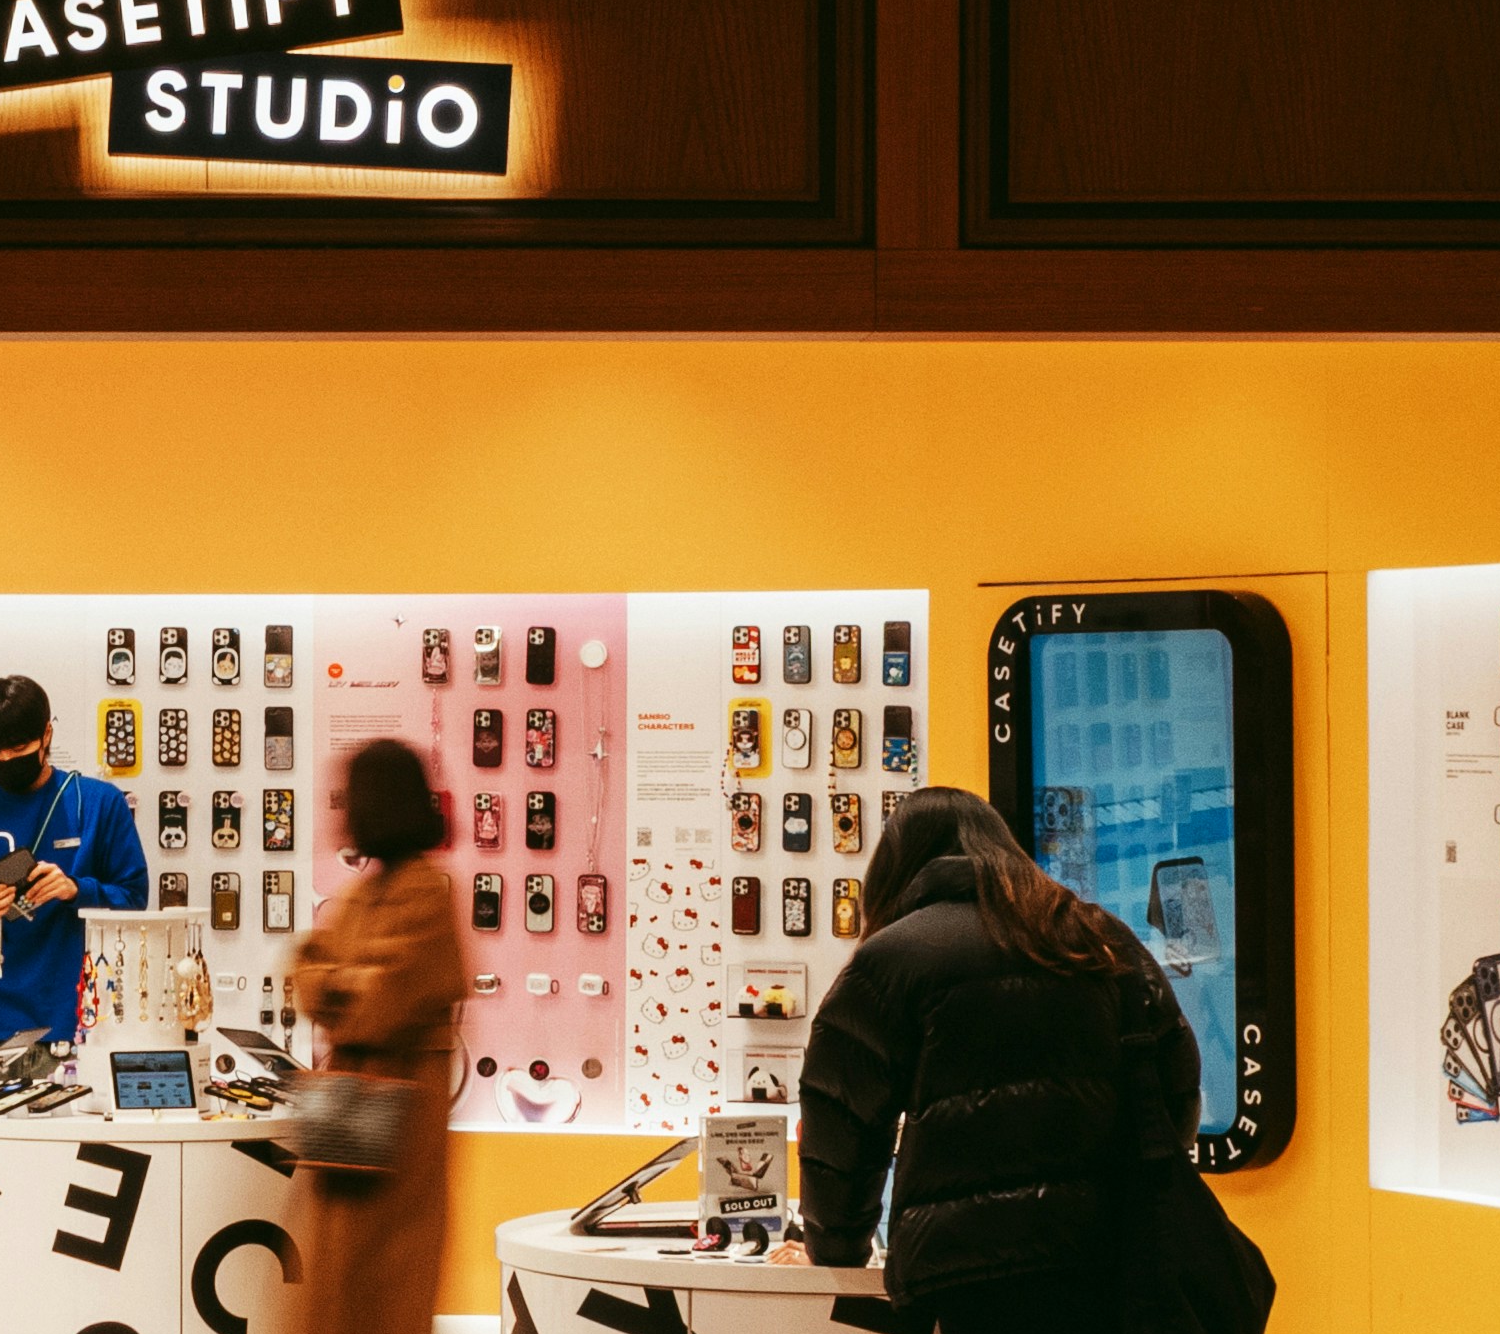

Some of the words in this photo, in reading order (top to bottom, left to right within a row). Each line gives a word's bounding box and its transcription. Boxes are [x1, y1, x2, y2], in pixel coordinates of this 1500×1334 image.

[144, 69, 479, 148] STUDiO
[994, 602, 1086, 743] CASETiFY
[1446, 711, 1470, 719] BLANK
[1446, 722, 1464, 730] CASE
[1188, 1024, 1262, 1166] CASETiF
[725, 1202, 751, 1212] SOLD
[753, 1198, 774, 1207] OUT
